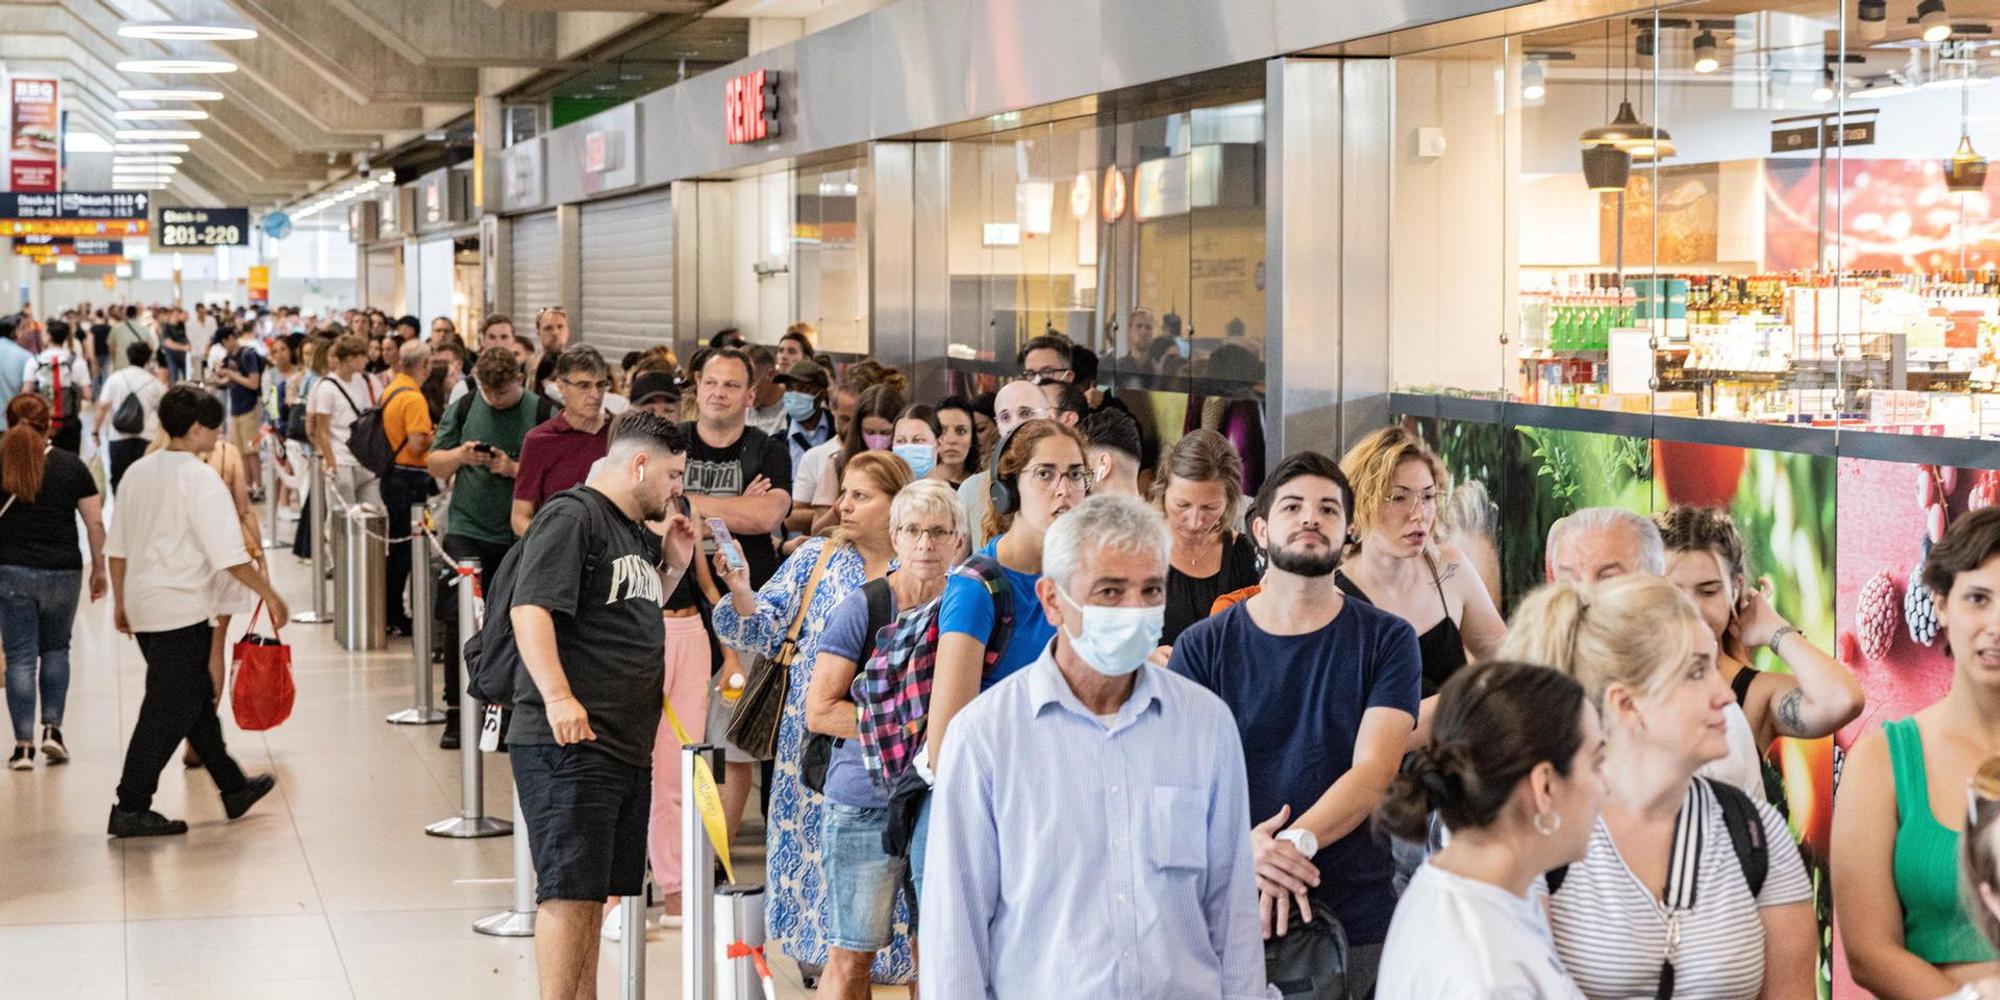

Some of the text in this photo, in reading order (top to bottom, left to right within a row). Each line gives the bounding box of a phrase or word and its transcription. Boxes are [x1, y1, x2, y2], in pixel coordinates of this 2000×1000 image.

[15, 81, 54, 97] BBQ
[726, 68, 767, 145] REWE
[163, 210, 208, 223] Check-in
[163, 225, 239, 245] 201-220
